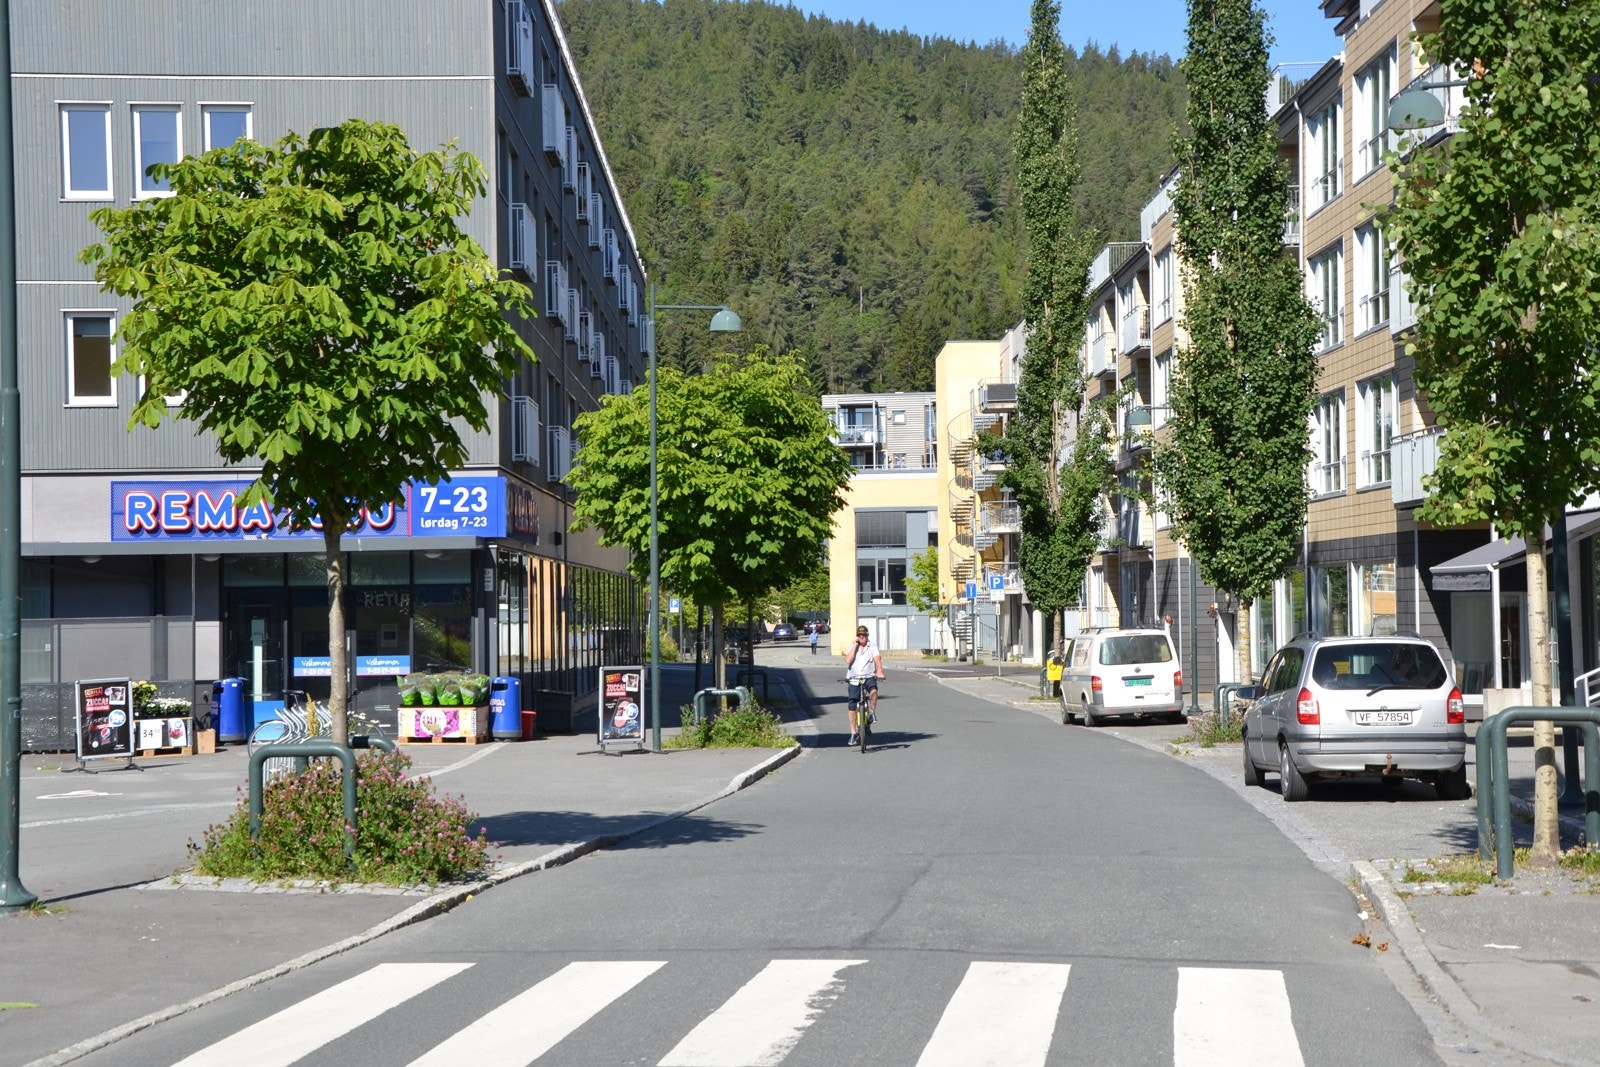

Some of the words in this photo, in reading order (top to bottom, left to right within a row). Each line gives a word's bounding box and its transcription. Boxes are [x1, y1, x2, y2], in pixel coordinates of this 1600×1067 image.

[420, 486, 488, 513] 7-23
[124, 490, 273, 531] REMA
[420, 516, 459, 530] lørdag
[461, 516, 488, 528] 7-23
[301, 658, 332, 667] Velkomme
[1359, 713, 1371, 721] VF
[1377, 712, 1409, 722] 57854
